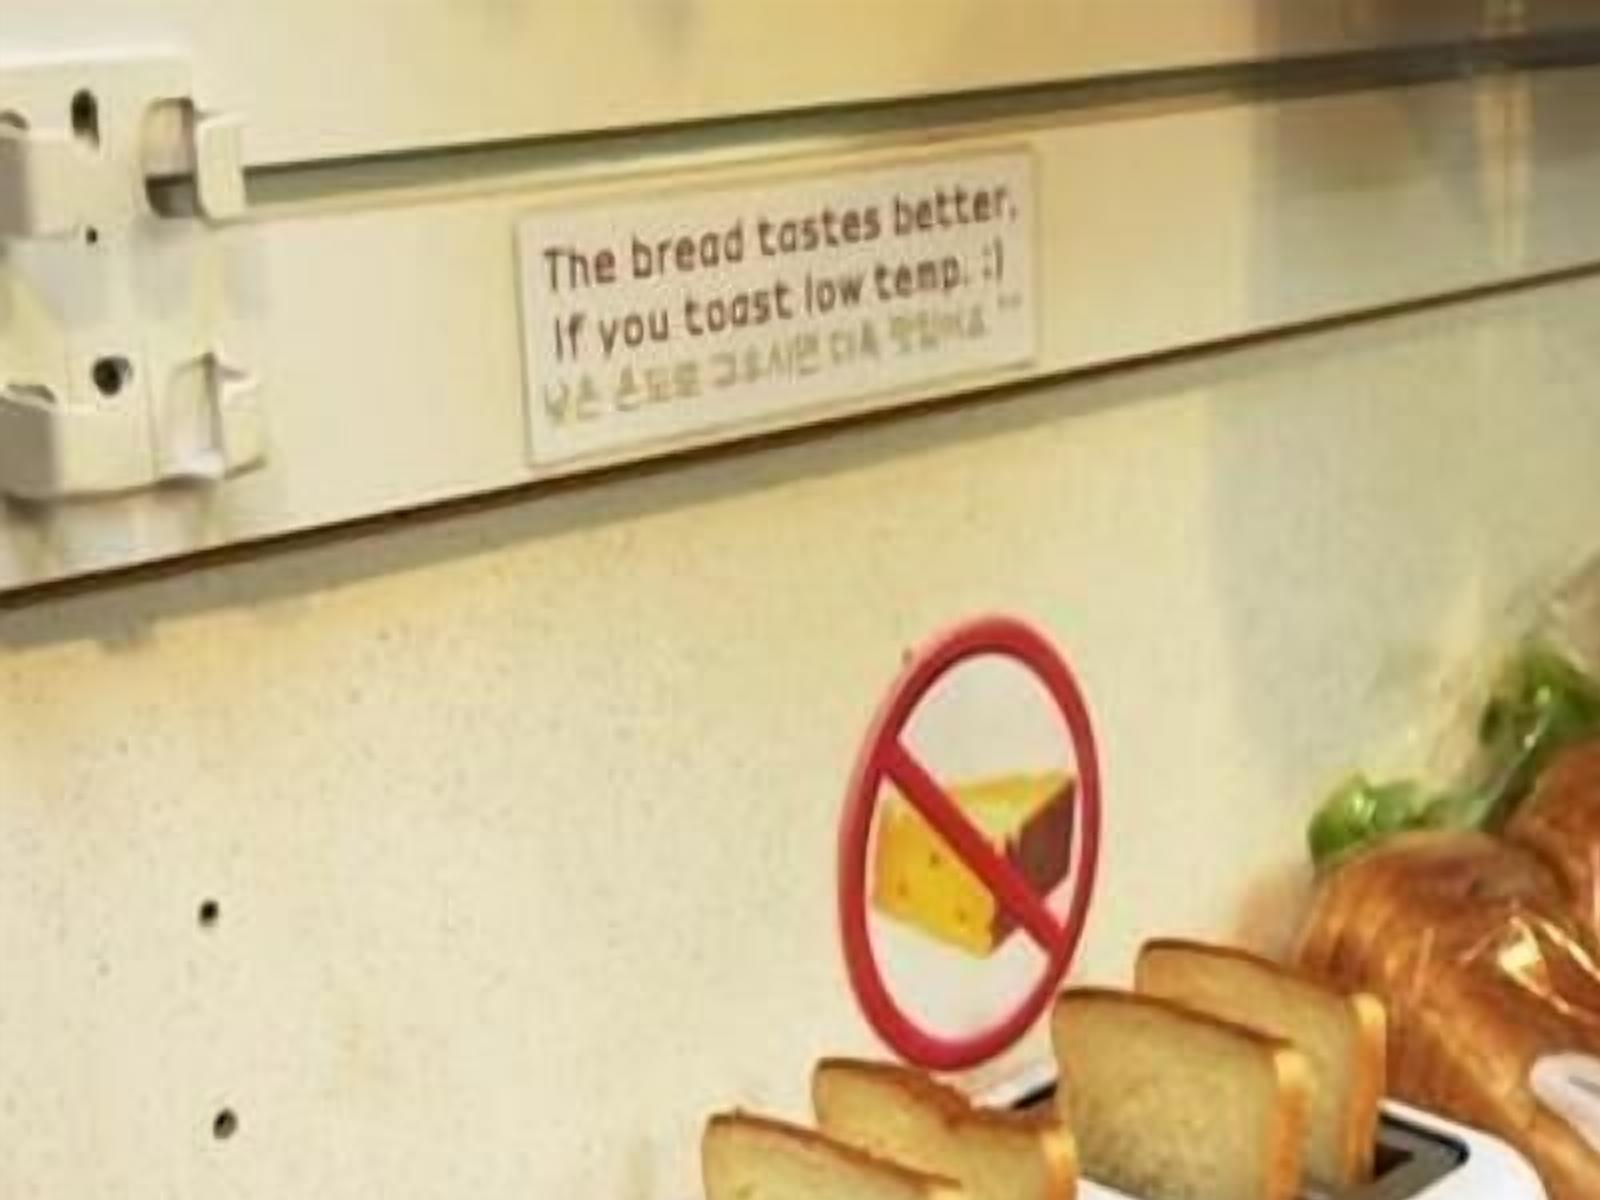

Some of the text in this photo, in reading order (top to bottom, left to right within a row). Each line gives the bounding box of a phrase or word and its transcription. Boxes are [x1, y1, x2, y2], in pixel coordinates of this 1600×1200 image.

[543, 244, 617, 291] The
[632, 227, 745, 280] bread
[757, 206, 881, 256] tastes
[554, 311, 586, 363] If
[599, 308, 669, 359] you
[684, 280, 793, 337] toast
[804, 270, 866, 317] low
